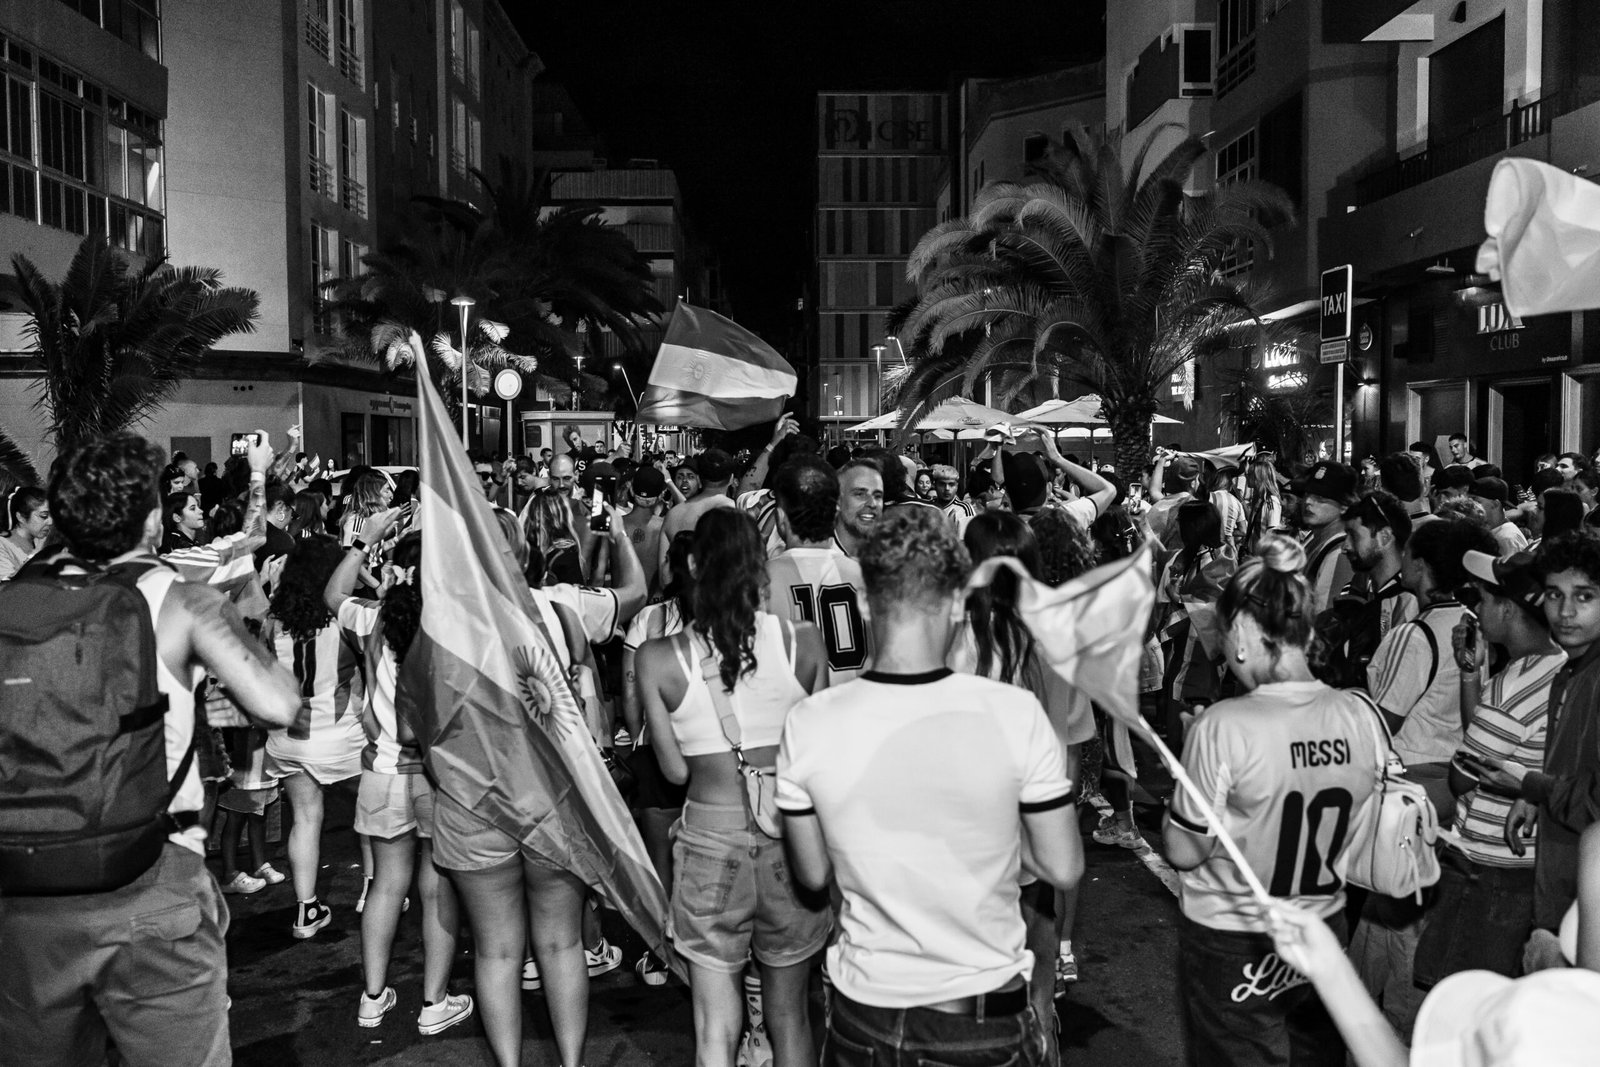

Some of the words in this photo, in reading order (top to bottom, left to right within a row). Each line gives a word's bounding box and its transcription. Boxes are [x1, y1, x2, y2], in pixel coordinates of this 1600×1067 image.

[1322, 291, 1347, 317] TAXI
[1490, 333, 1520, 351] CLUB
[790, 583, 868, 672] 10
[1290, 738, 1351, 769] MESSI
[1269, 787, 1353, 896] 10
